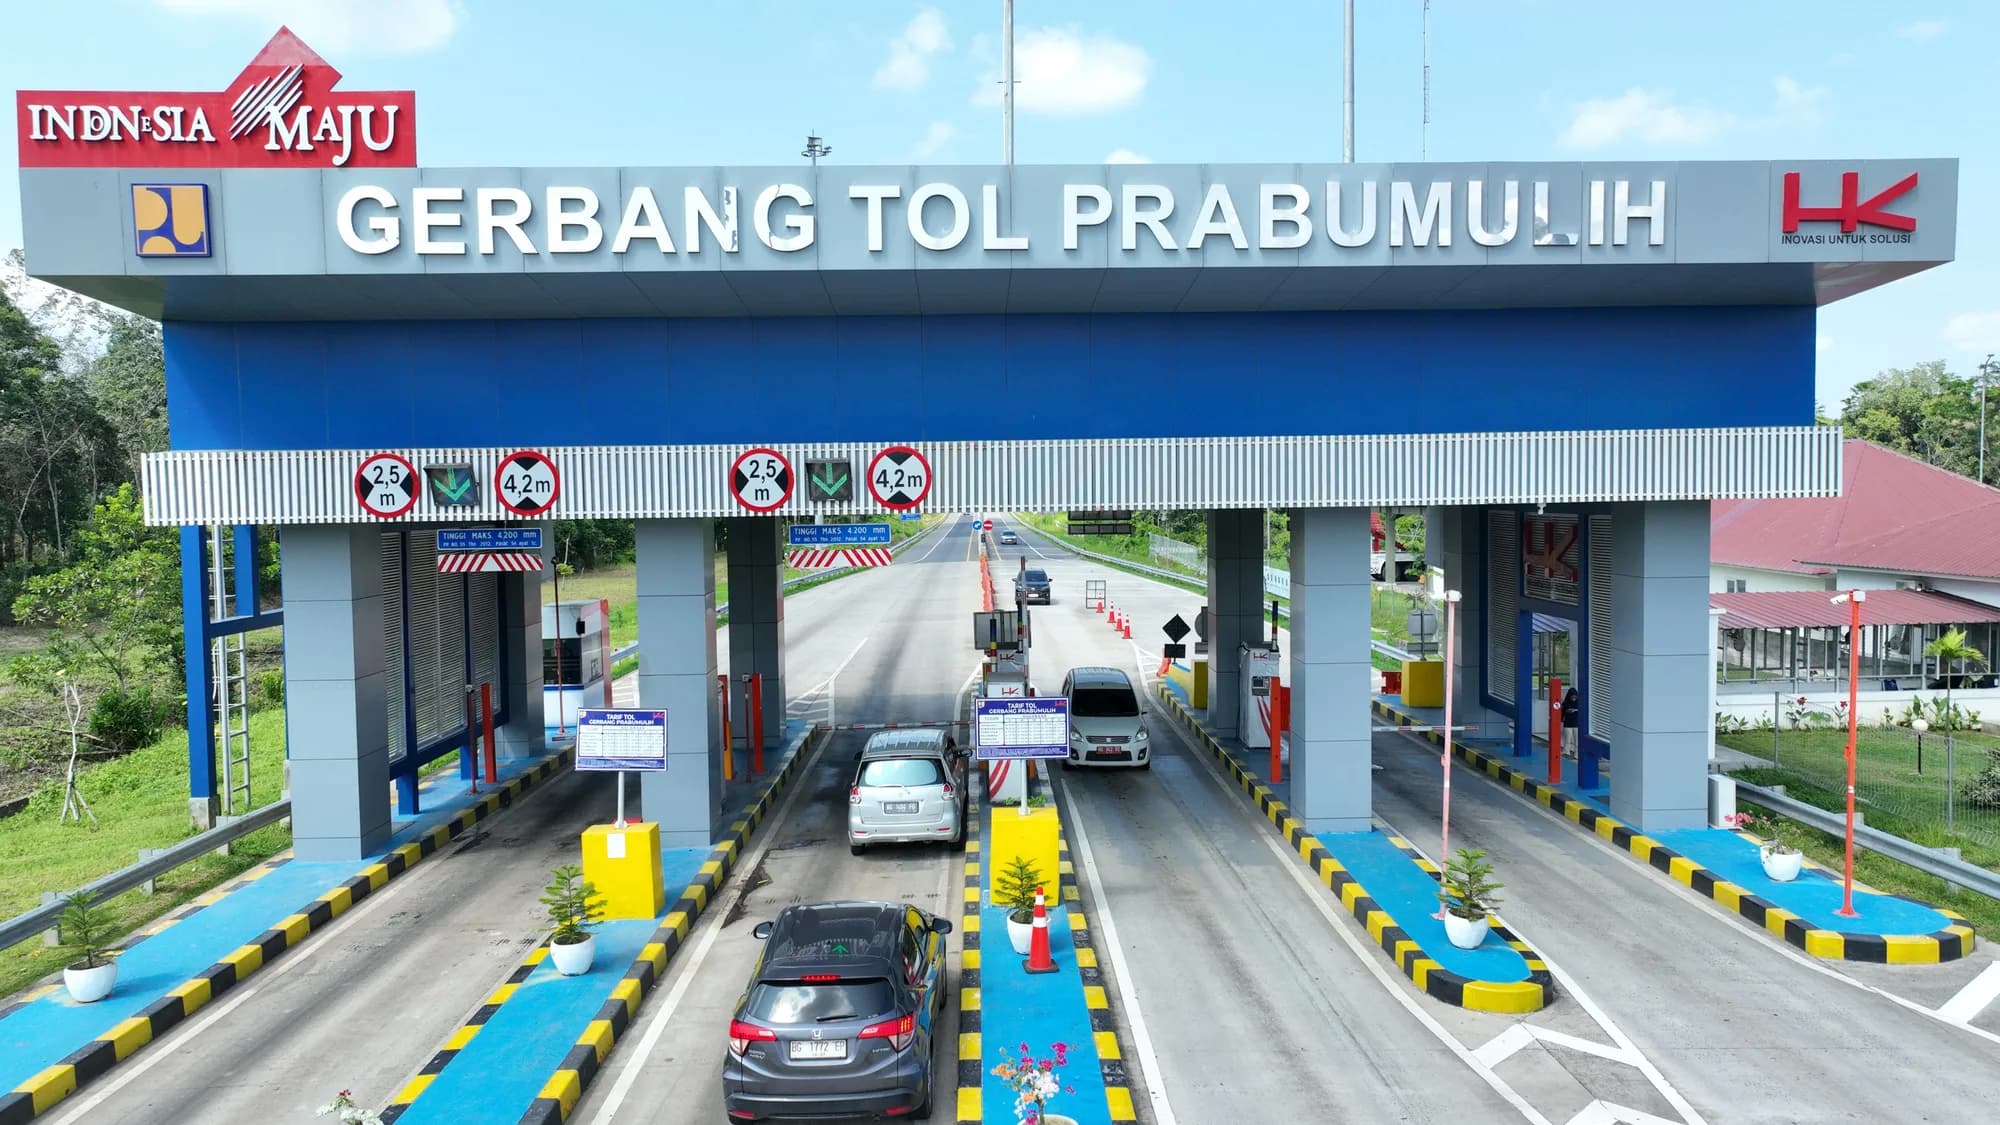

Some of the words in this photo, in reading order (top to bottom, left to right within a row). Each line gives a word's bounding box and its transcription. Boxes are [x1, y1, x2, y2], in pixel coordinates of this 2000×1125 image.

[264, 104, 400, 168] MAJU
[1782, 171, 1918, 233] HK
[336, 184, 816, 256] GERBANG
[848, 182, 1029, 252] TOL
[1062, 180, 1666, 251] PRABUMULIH
[1782, 235, 1825, 244] INOVASI
[1829, 235, 1867, 244] UNTUK
[1870, 234, 1911, 244] SOLUSI
[373, 465, 400, 488] 2,5
[749, 459, 776, 482] 2,5
[380, 491, 395, 506] m
[755, 487, 770, 501] m
[443, 532, 466, 540] TINGGI
[794, 527, 817, 536] TINGGI
[810, 1041, 828, 1051] 1772
